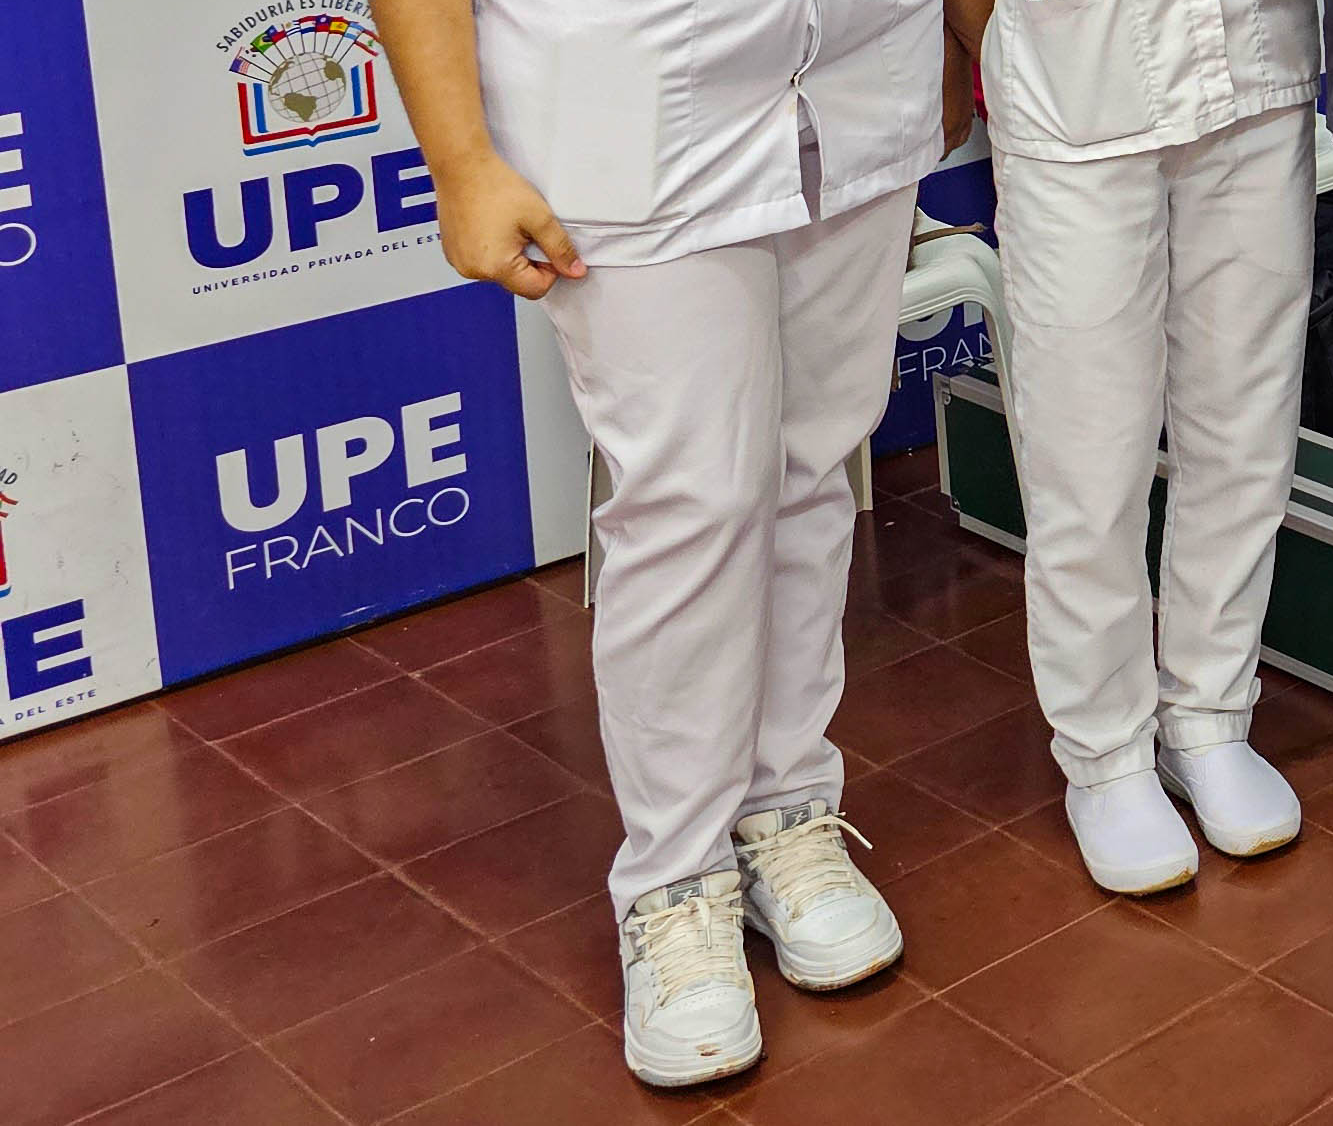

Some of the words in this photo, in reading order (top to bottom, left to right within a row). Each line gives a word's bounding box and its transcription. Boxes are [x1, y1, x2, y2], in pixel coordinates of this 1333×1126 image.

[216, 0, 295, 54] SABIDURIA
[183, 146, 439, 269] UPE
[192, 264, 300, 296] UNIVERSIDAD
[308, 247, 374, 269] PRIVADA
[382, 240, 409, 253] DEL
[417, 232, 442, 245] EST
[215, 391, 468, 532] UPE
[225, 486, 470, 591] FRANCO
[15, 705, 47, 722] DEL
[55, 688, 97, 709] ESTE
